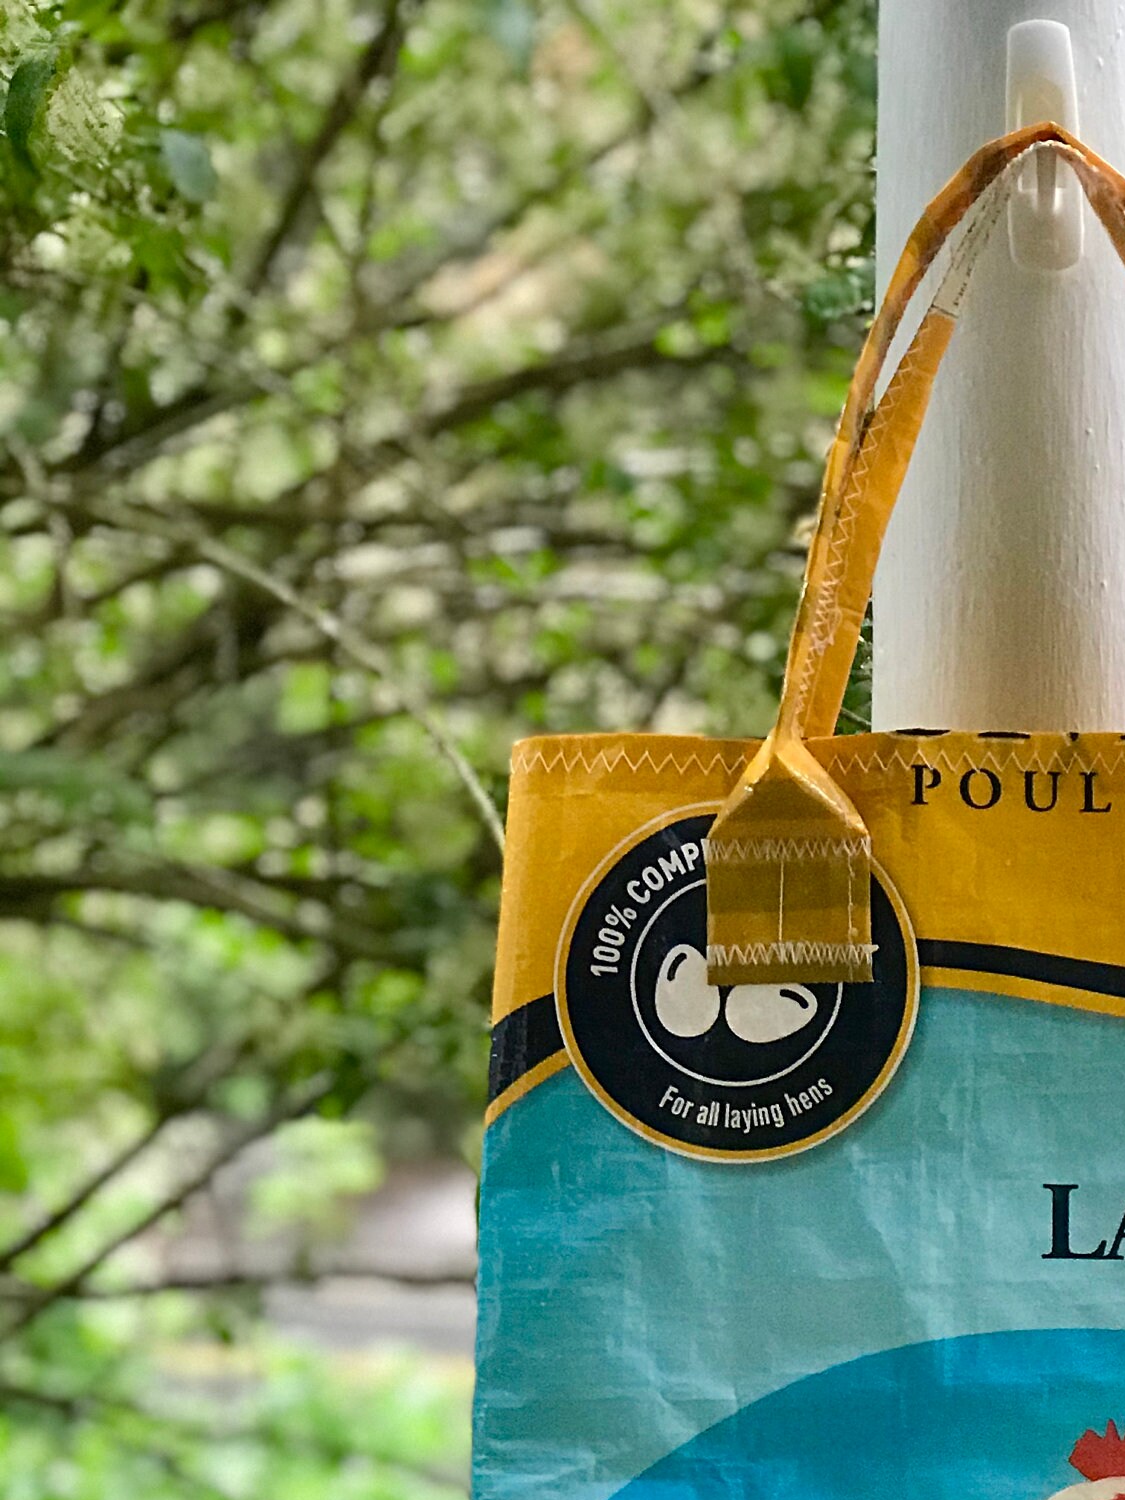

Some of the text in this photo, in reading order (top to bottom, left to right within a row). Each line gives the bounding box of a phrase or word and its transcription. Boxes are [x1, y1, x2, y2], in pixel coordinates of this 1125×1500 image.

[590, 904, 638, 977] 100%
[658, 1078, 834, 1134] For all laying hens
